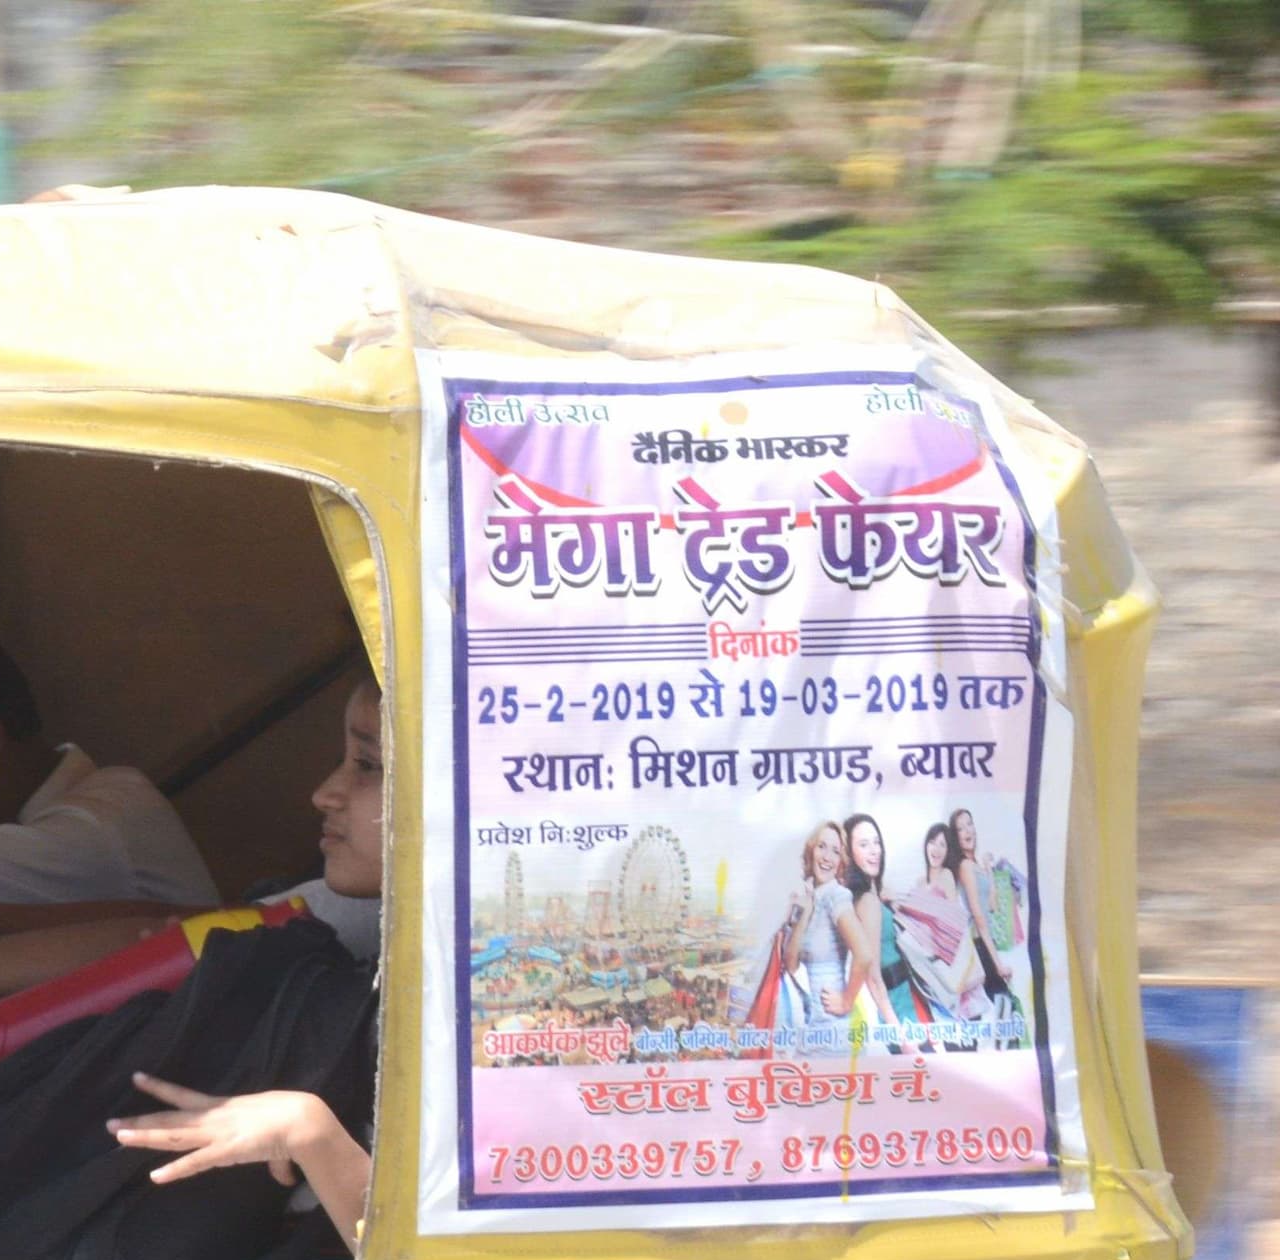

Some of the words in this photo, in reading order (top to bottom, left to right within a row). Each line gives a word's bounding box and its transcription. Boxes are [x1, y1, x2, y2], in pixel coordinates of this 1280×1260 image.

[466, 396, 524, 423] होली
[865, 386, 924, 414] होली
[631, 428, 729, 465] दैनिक
[736, 434, 850, 461] भास्कर
[485, 478, 659, 594] मेगा
[675, 475, 793, 608] ट्रेड
[814, 470, 1004, 587] फेयर
[709, 619, 799, 662] दिनांक
[478, 681, 676, 725] 25-2-2019
[689, 667, 725, 718] से
[739, 673, 949, 717] 19-03-2019
[957, 675, 1028, 710] तक
[502, 752, 614, 793] स्थान:
[628, 735, 739, 789] मिशन
[750, 745, 883, 791] ग्राउण्ड,
[898, 741, 997, 779] ब्यावर
[477, 821, 532, 846] प्रवेश
[484, 1022, 580, 1056] आकर्षक
[585, 1018, 631, 1063] झूले
[578, 1066, 712, 1113] स्टॉल
[725, 1061, 880, 1121] बुकिंग
[890, 1056, 942, 1101] नं.
[490, 1139, 764, 1182] 7300339757,
[781, 1125, 1035, 1171] 8769378500
